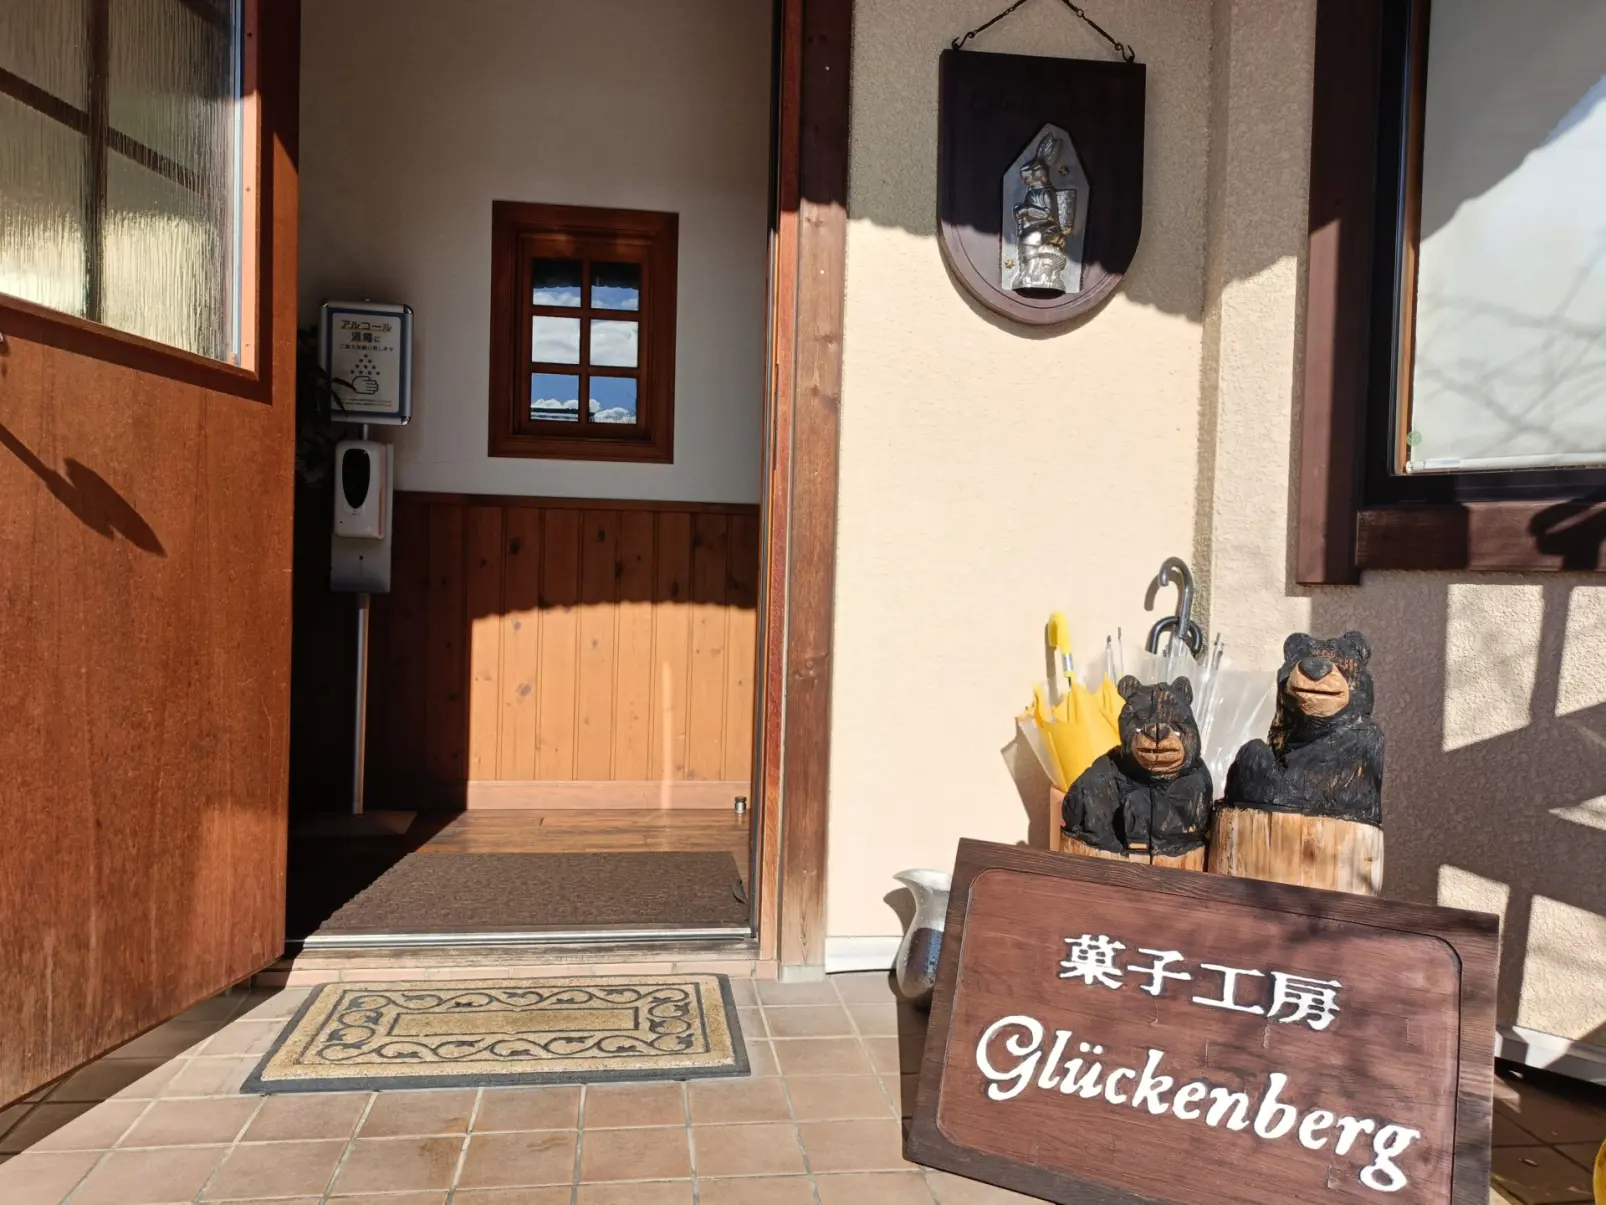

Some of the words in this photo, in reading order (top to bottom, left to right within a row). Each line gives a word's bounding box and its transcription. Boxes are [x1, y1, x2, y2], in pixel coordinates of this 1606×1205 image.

[340, 319, 392, 331] アルコール
[1059, 934, 1343, 1031] 菓子工房
[975, 1015, 1421, 1192] Glückenberg
